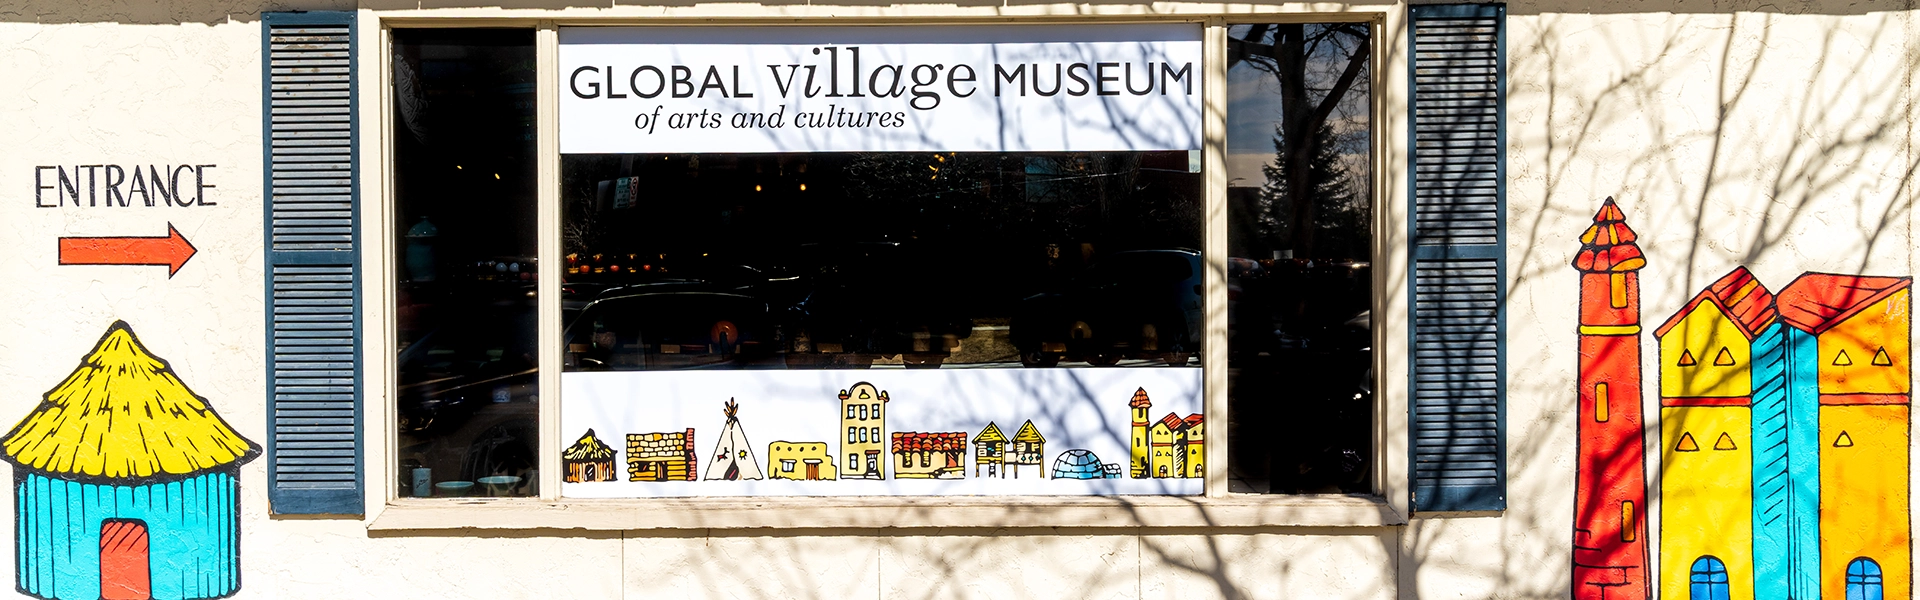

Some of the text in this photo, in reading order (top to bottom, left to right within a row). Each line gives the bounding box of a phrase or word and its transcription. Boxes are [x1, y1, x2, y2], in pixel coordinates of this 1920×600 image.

[569, 46, 1192, 110] GLOBAL village MUSEUM
[634, 104, 906, 135] of arts and cultures
[35, 164, 217, 208] ENTRANCE
